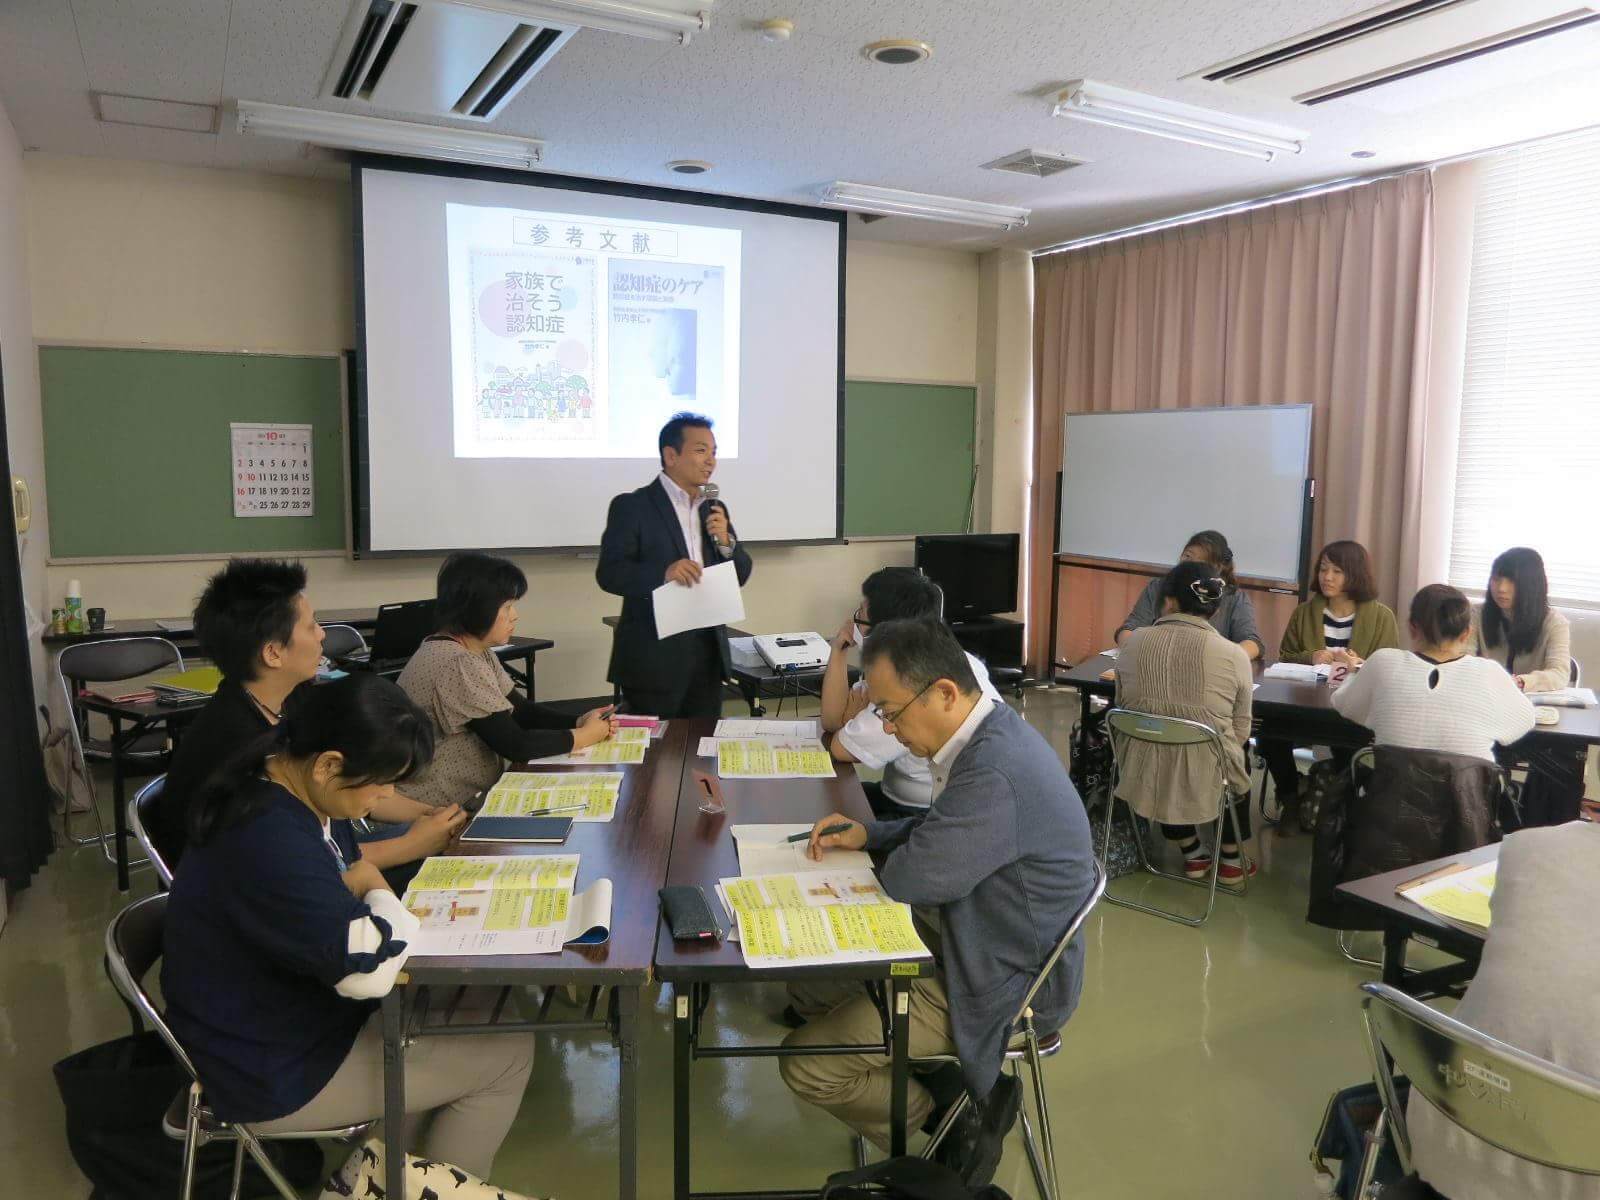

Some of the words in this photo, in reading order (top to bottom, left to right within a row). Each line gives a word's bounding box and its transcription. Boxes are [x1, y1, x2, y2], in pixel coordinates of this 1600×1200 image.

[530, 224, 650, 253] 参考文献
[505, 272, 564, 292] 家族で
[613, 272, 703, 296] 認知症のケア
[505, 293, 562, 312] 治そう
[505, 314, 565, 333] 認知症
[266, 432, 278, 440] 10
[238, 459, 242, 467] 2
[292, 460, 296, 468] 7
[237, 488, 245, 496] 16
[1332, 666, 1348, 682] 2
[699, 778, 713, 796] 1
